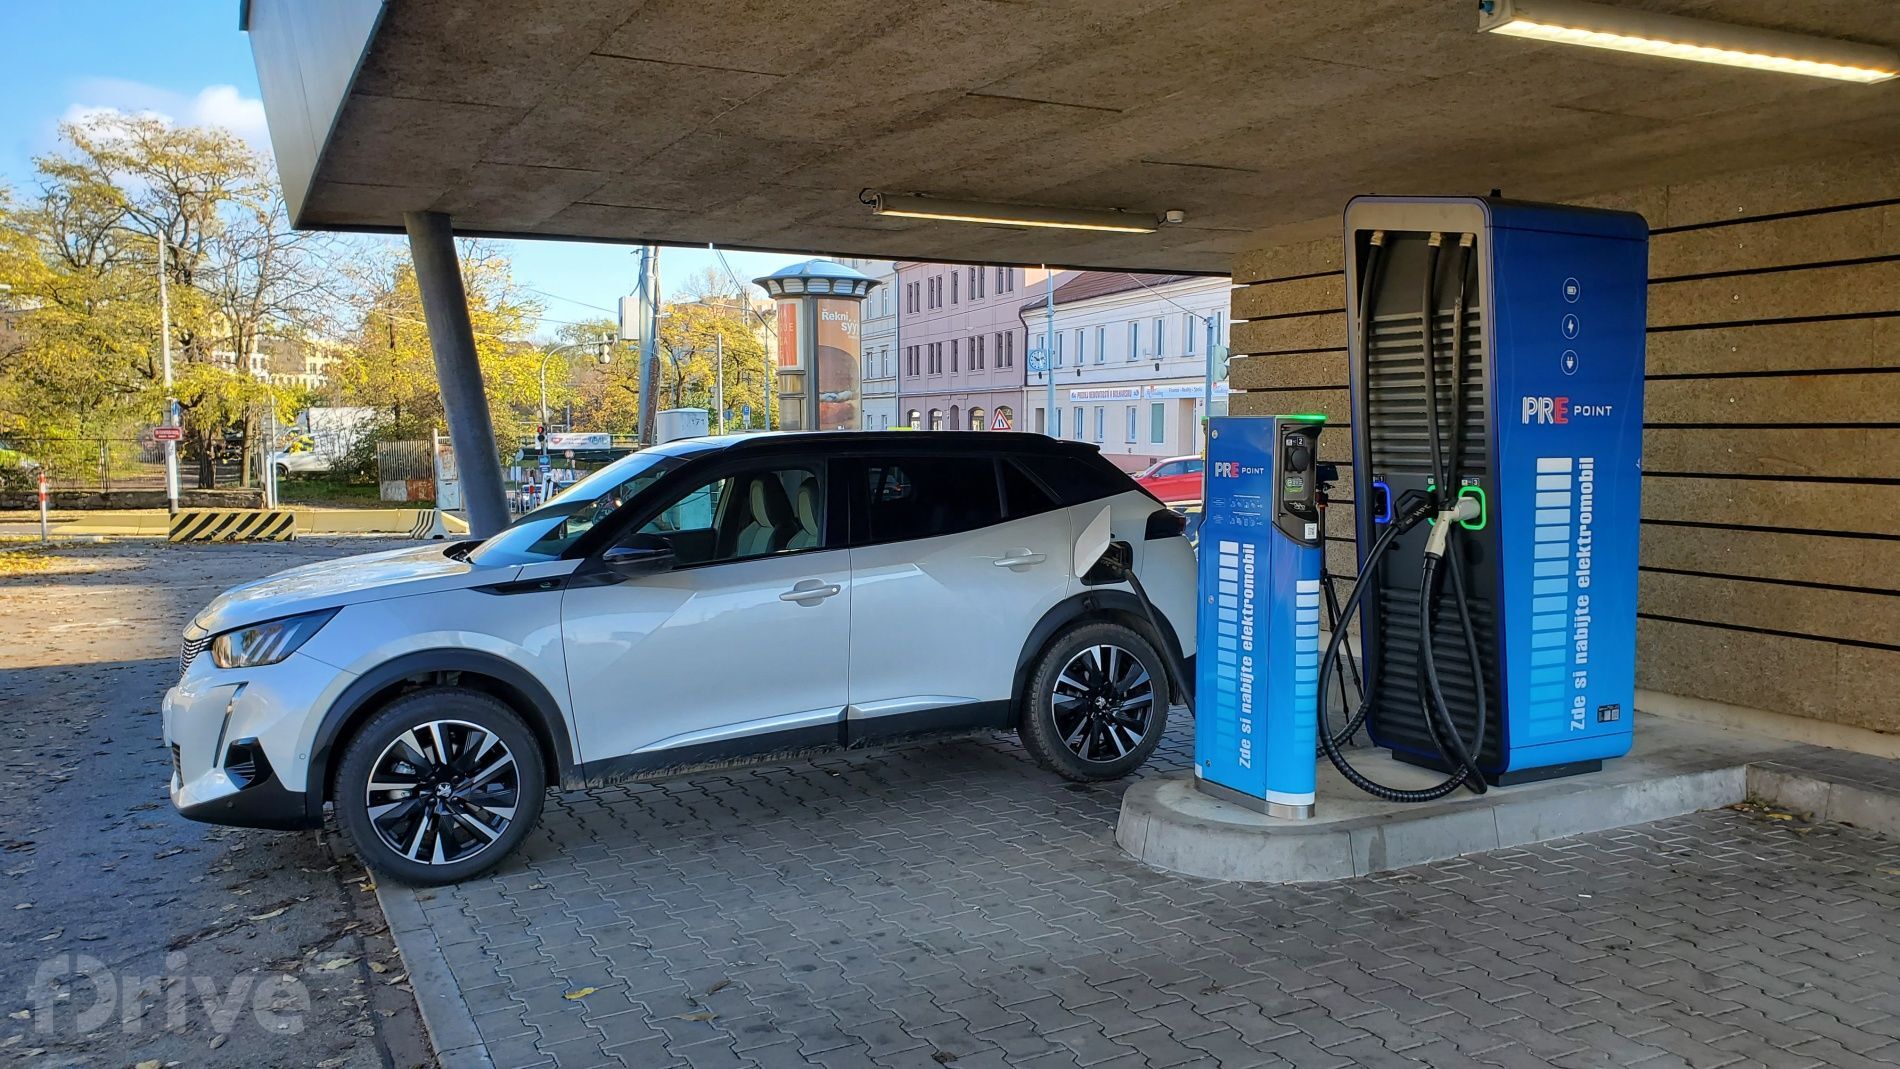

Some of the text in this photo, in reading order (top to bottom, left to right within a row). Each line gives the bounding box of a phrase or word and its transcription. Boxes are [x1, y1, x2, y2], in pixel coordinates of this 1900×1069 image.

[1214, 461, 1265, 478] PRE POINT
[1522, 396, 1613, 425] PRE POINT
[1239, 543, 1255, 769] Zde si nabijte elektromobil
[1570, 457, 1594, 732] Zde si nabijte elektromobil
